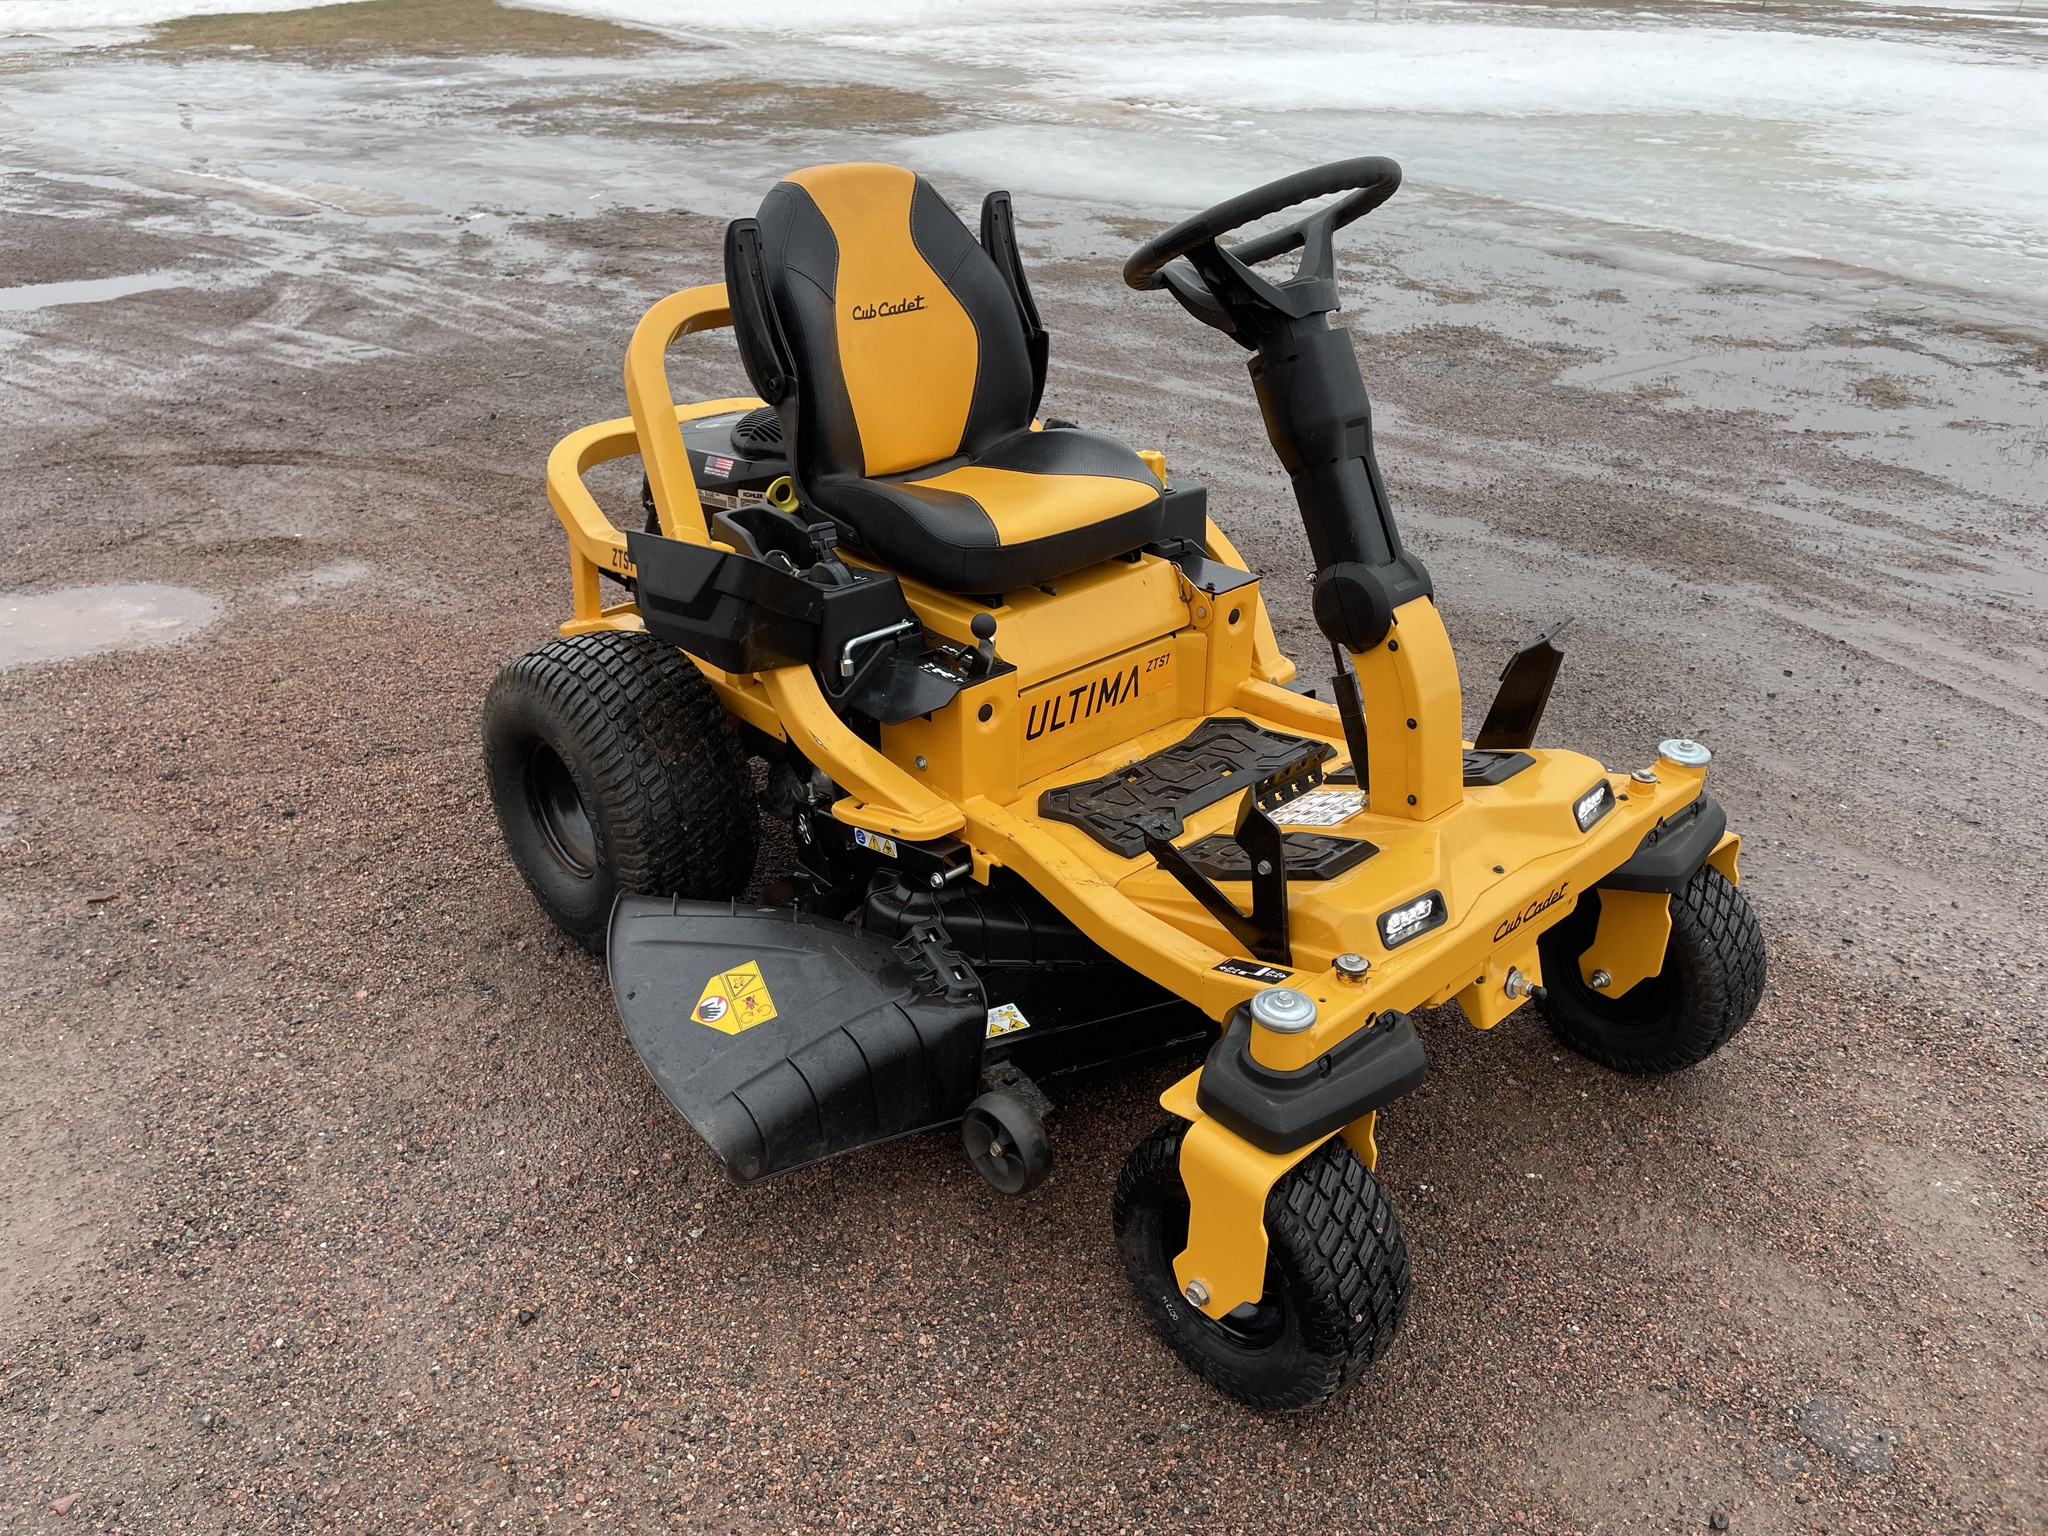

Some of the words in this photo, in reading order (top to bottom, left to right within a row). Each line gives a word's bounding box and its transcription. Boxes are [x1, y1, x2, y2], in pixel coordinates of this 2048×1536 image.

[852, 303, 877, 321] Cub
[878, 294, 925, 317] Cadet
[743, 491, 764, 499] KOHLER
[1145, 652, 1171, 673] ZTS1
[1025, 664, 1139, 741] ULTIMA
[1493, 911, 1522, 943] Cub
[1523, 881, 1570, 923] Cadet
